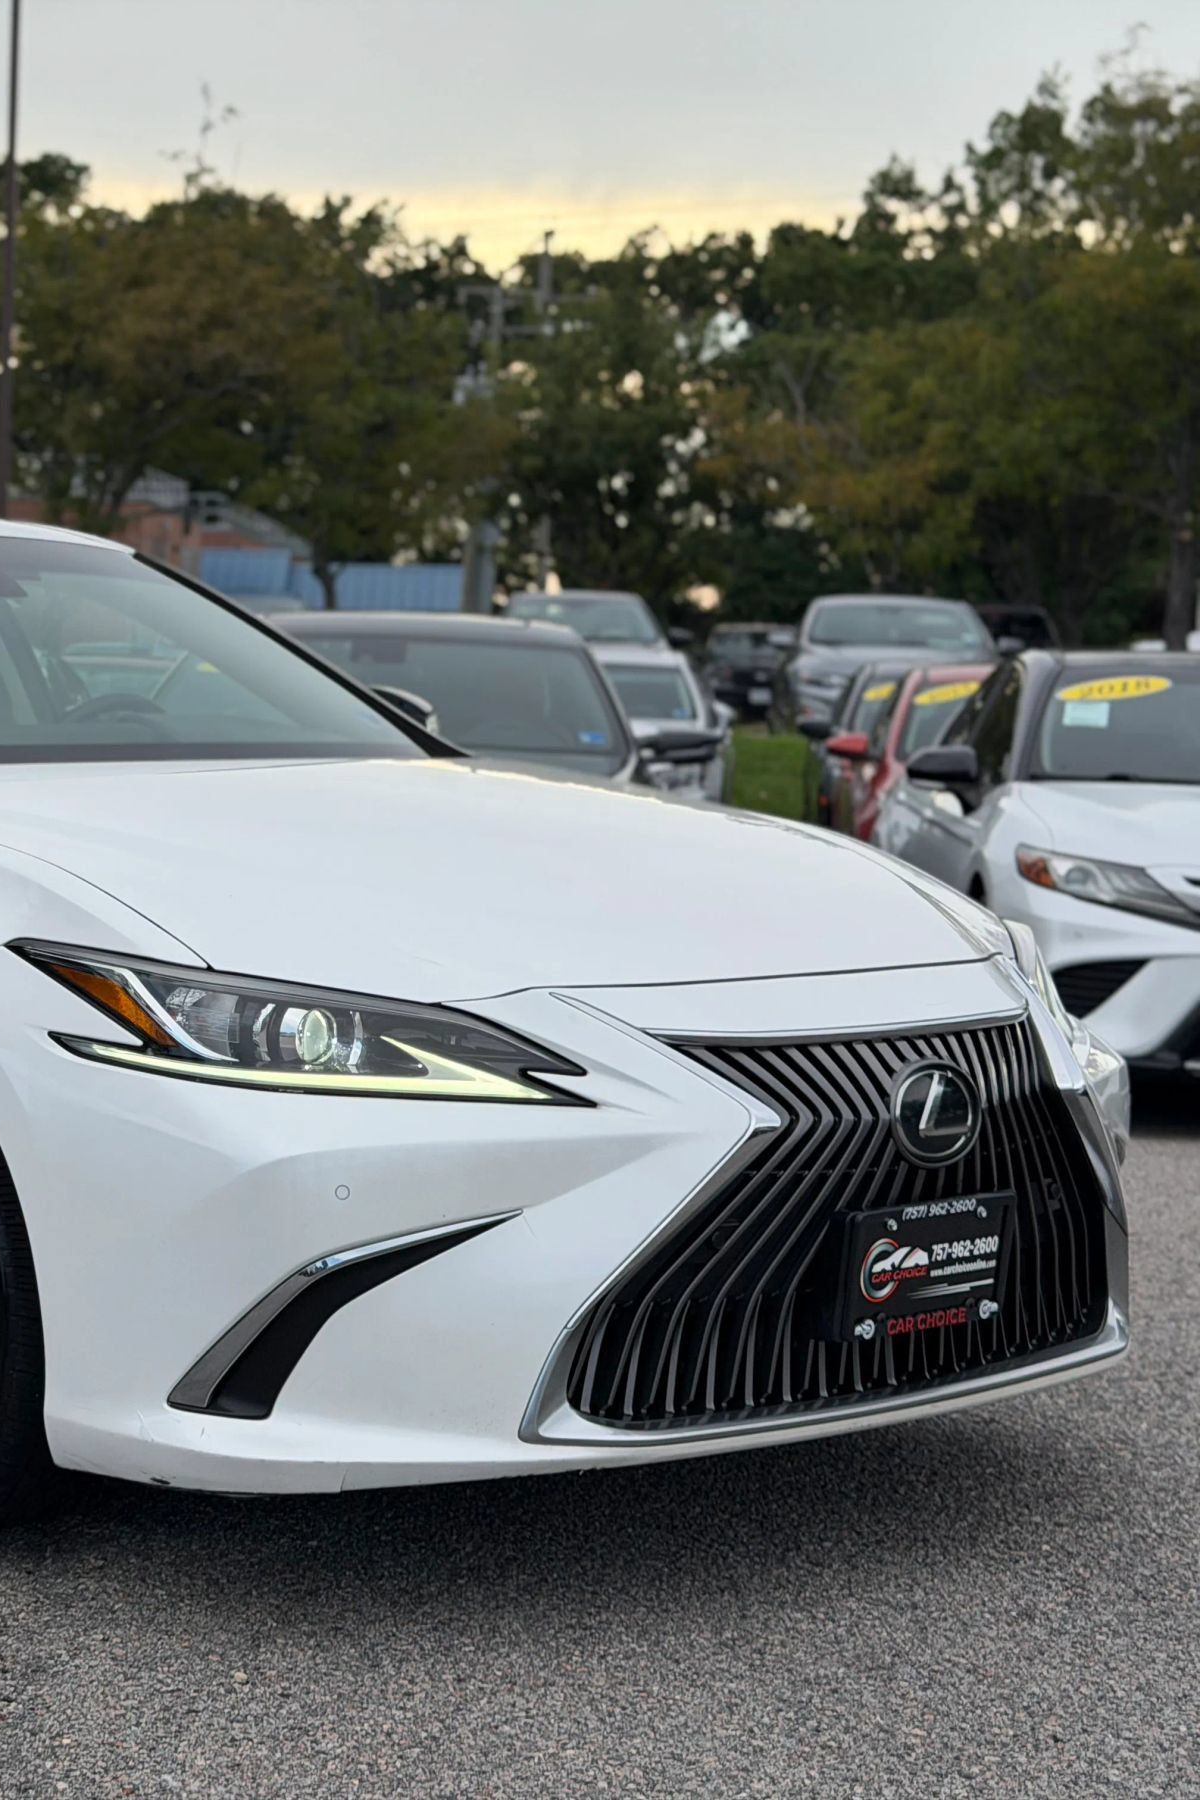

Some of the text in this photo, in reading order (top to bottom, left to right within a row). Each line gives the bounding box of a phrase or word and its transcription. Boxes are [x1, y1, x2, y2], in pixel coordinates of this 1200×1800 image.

[902, 1198, 976, 1221] (757) 962-2600
[932, 1236, 998, 1260] 757-962-2600
[872, 1266, 928, 1283] CAR CHOICE
[887, 1307, 967, 1336] CAR CHOICE
